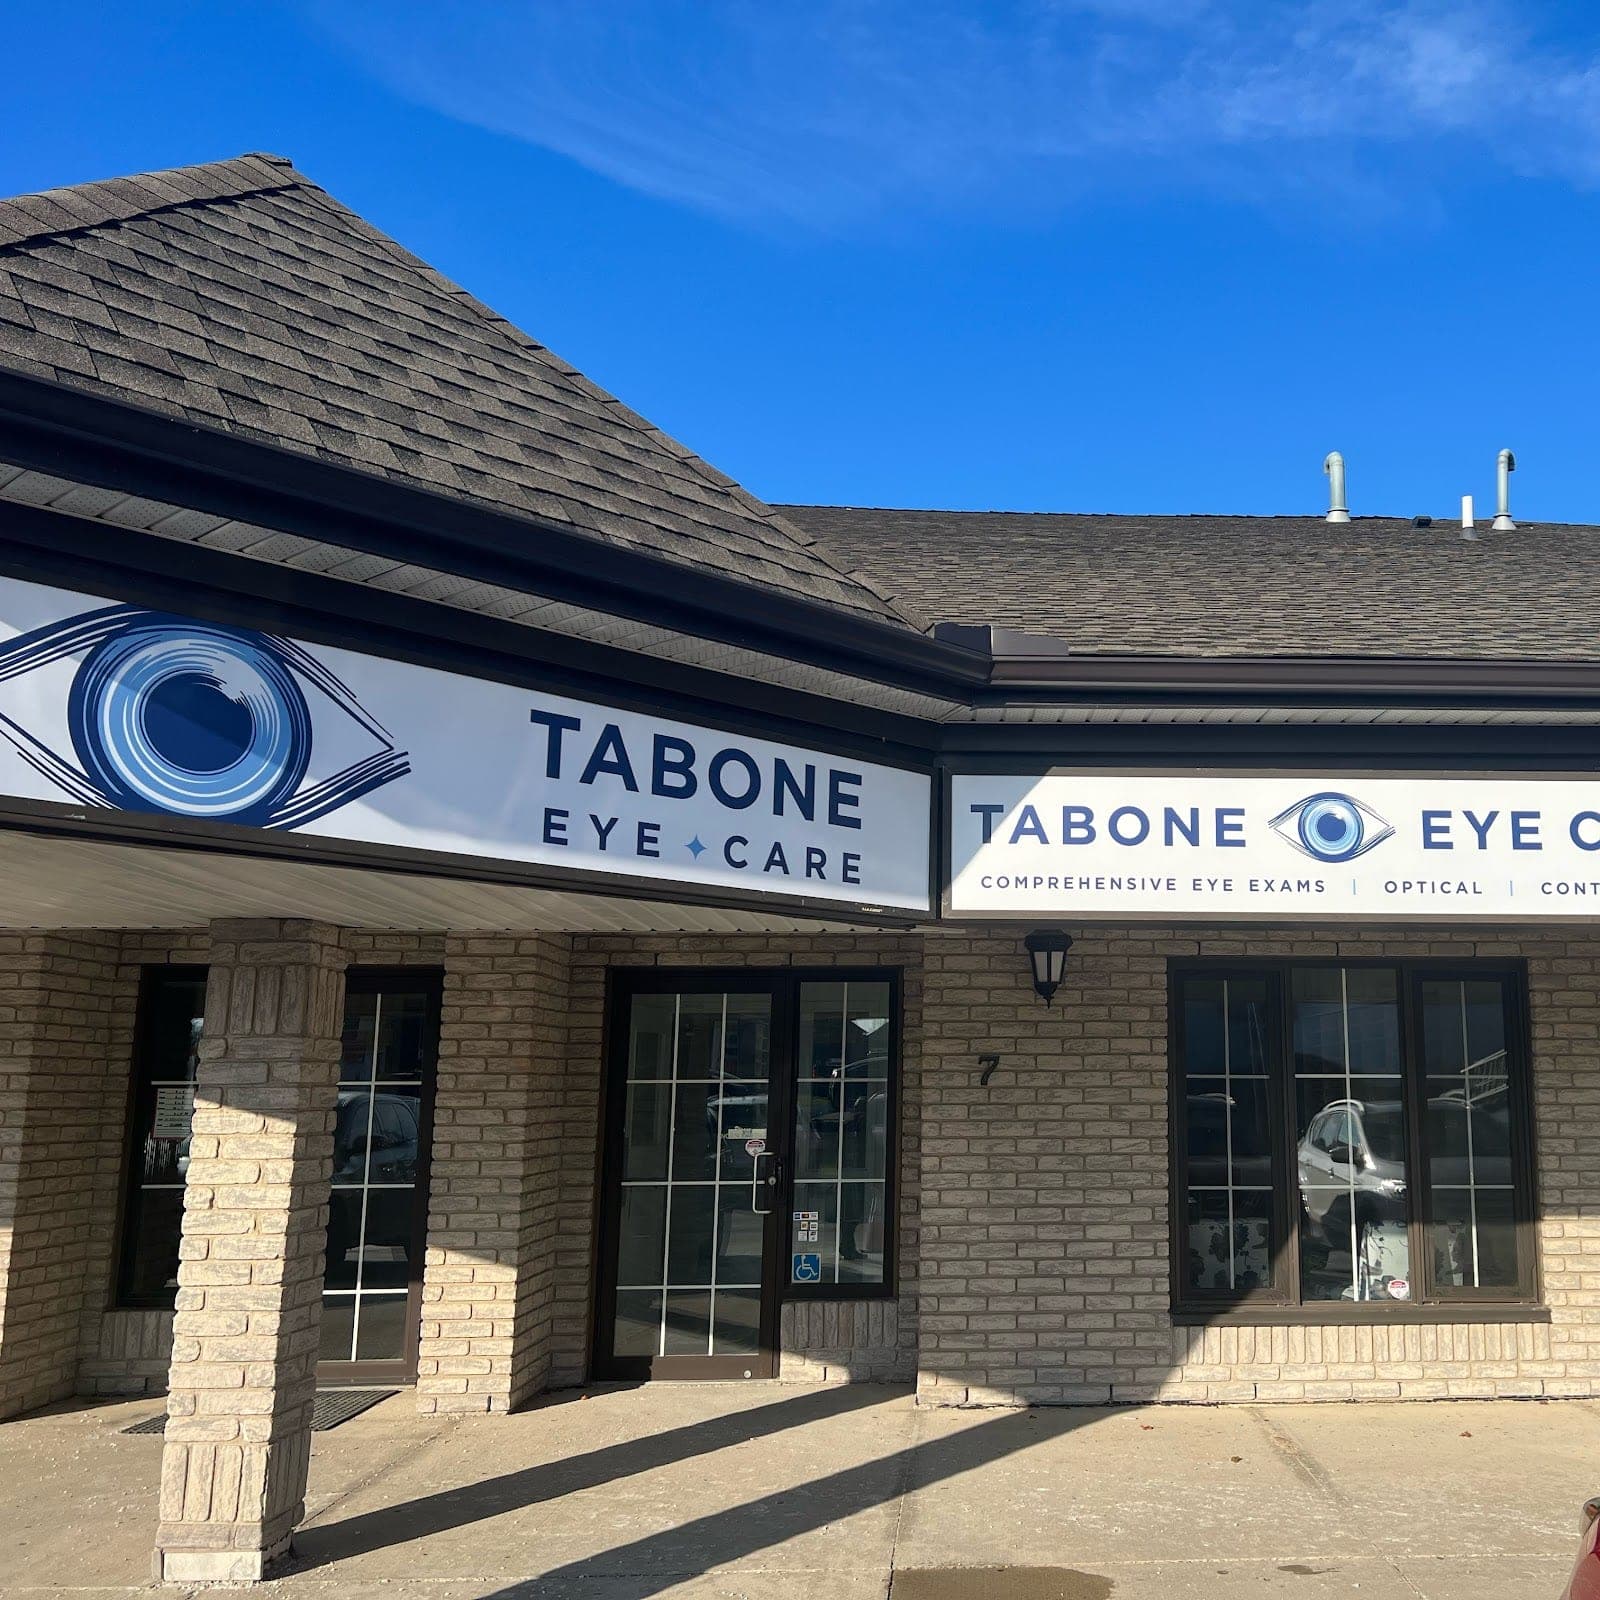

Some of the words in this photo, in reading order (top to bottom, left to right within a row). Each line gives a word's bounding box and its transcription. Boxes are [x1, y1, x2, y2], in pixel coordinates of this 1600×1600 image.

[529, 709, 863, 830] TABONE
[970, 804, 1247, 847] TABONE
[1421, 809, 1543, 851] EYE
[542, 807, 661, 858] EYE
[723, 835, 861, 885] CARE
[981, 875, 1177, 891] COMPREHENSIVE
[1192, 878, 1233, 892] EYE
[1249, 879, 1325, 893] EXAMS
[1384, 880, 1483, 895] OPTICAL
[1541, 882, 1600, 895] CONT
[977, 1054, 1000, 1086] 7
